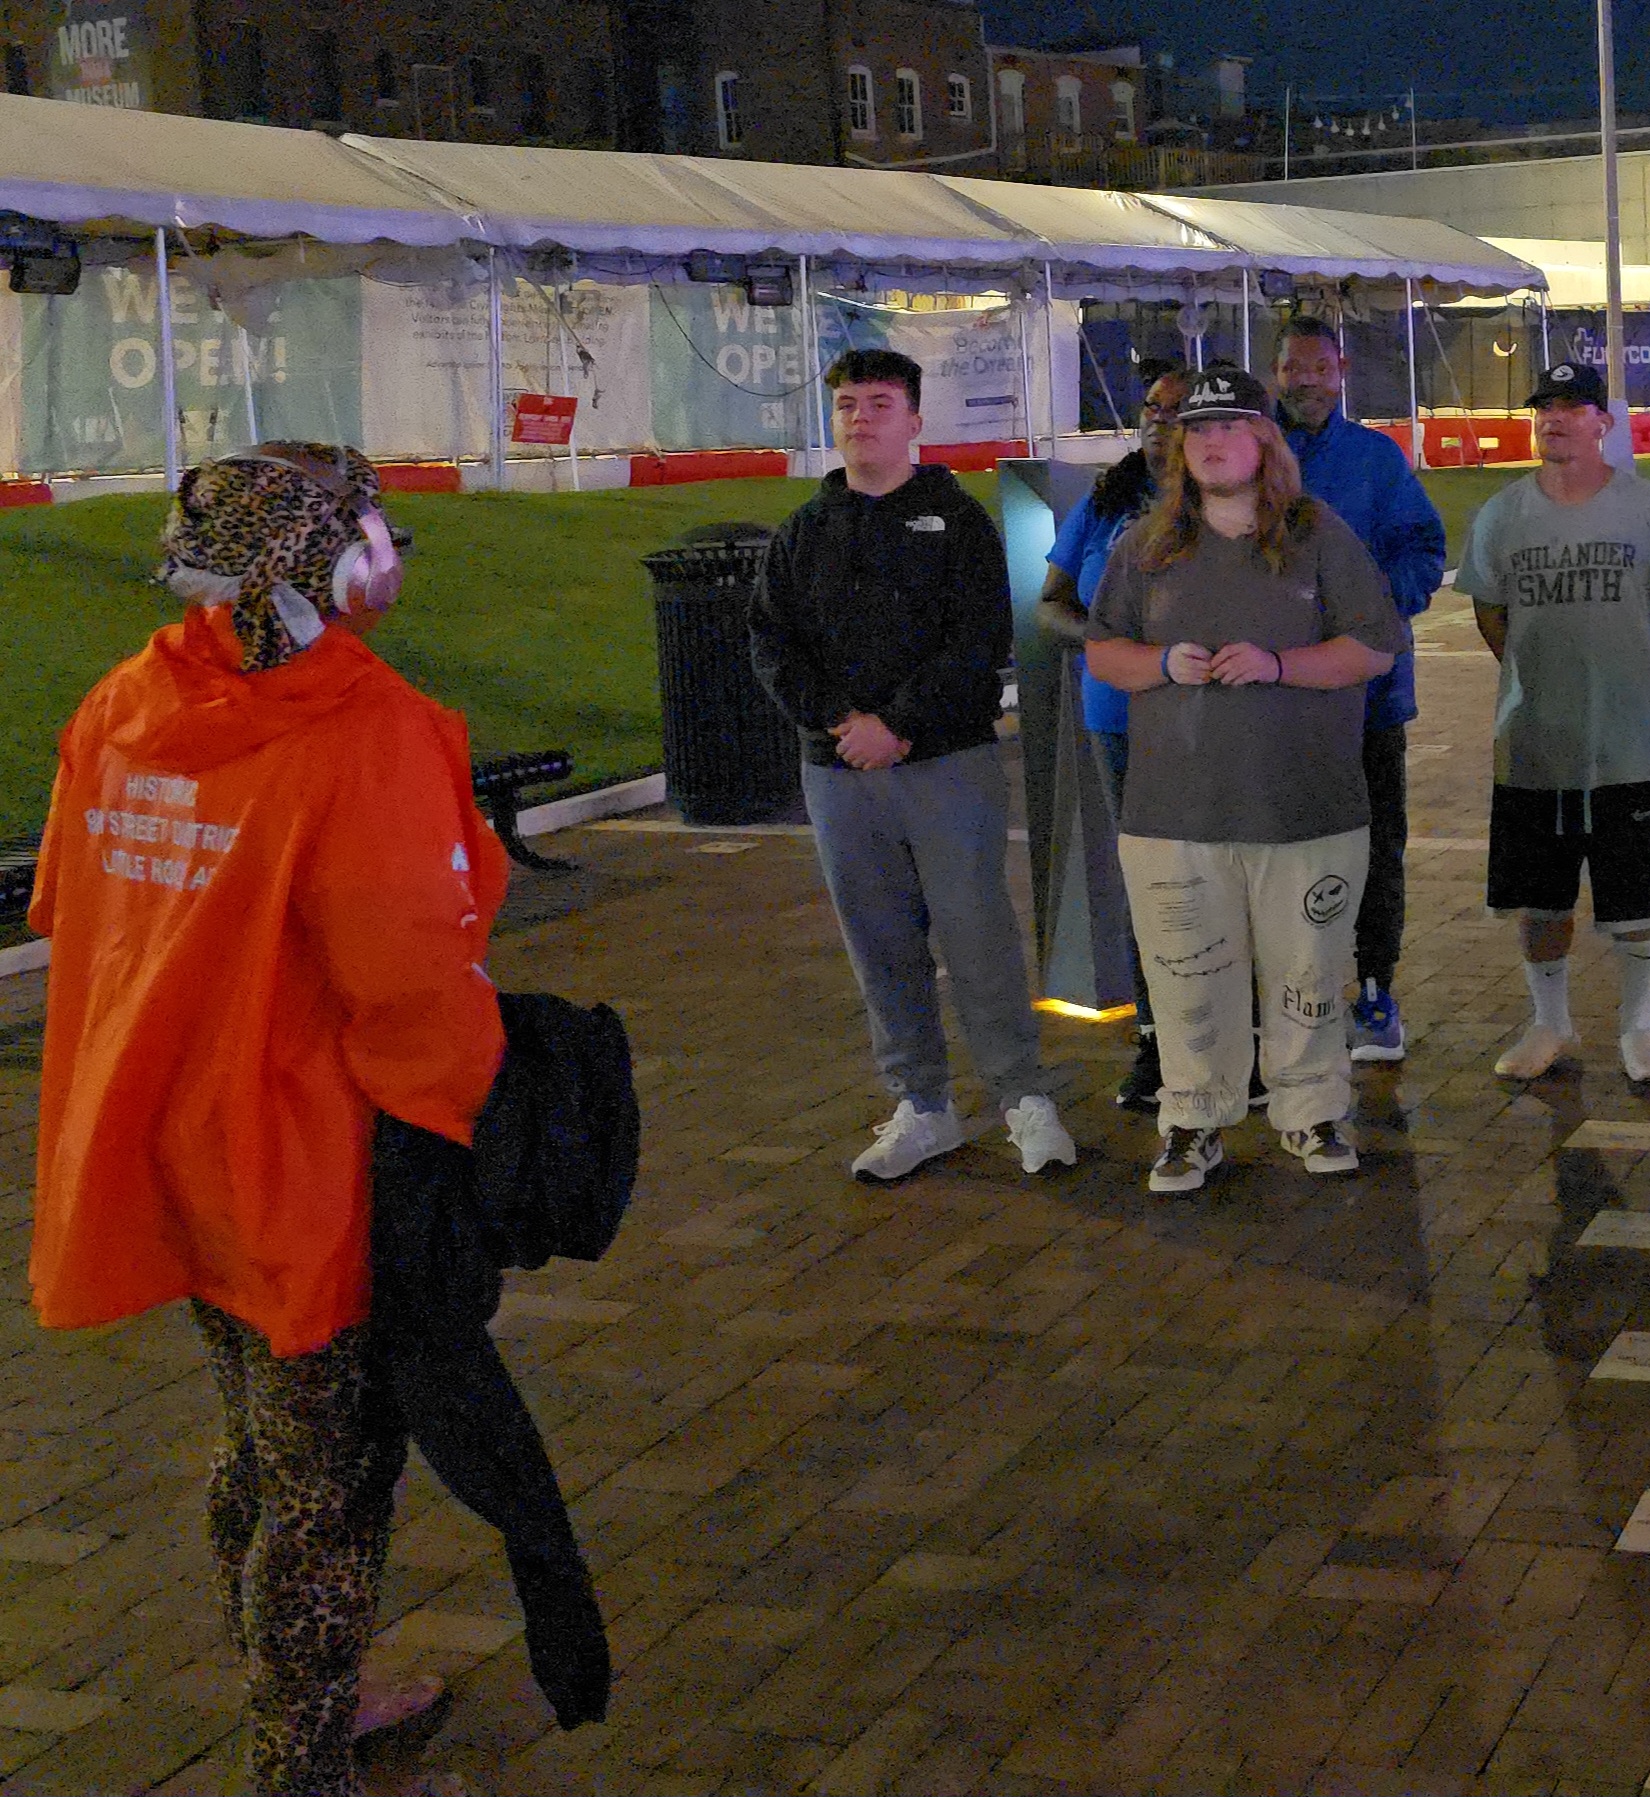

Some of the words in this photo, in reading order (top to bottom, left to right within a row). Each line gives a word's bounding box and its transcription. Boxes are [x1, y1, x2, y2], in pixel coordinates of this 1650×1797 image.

[58, 17, 129, 66] MORE
[716, 344, 828, 384] OPE
[941, 358, 970, 378] the
[1510, 542, 1636, 572] PHILANDER
[1519, 568, 1623, 607] SMITH
